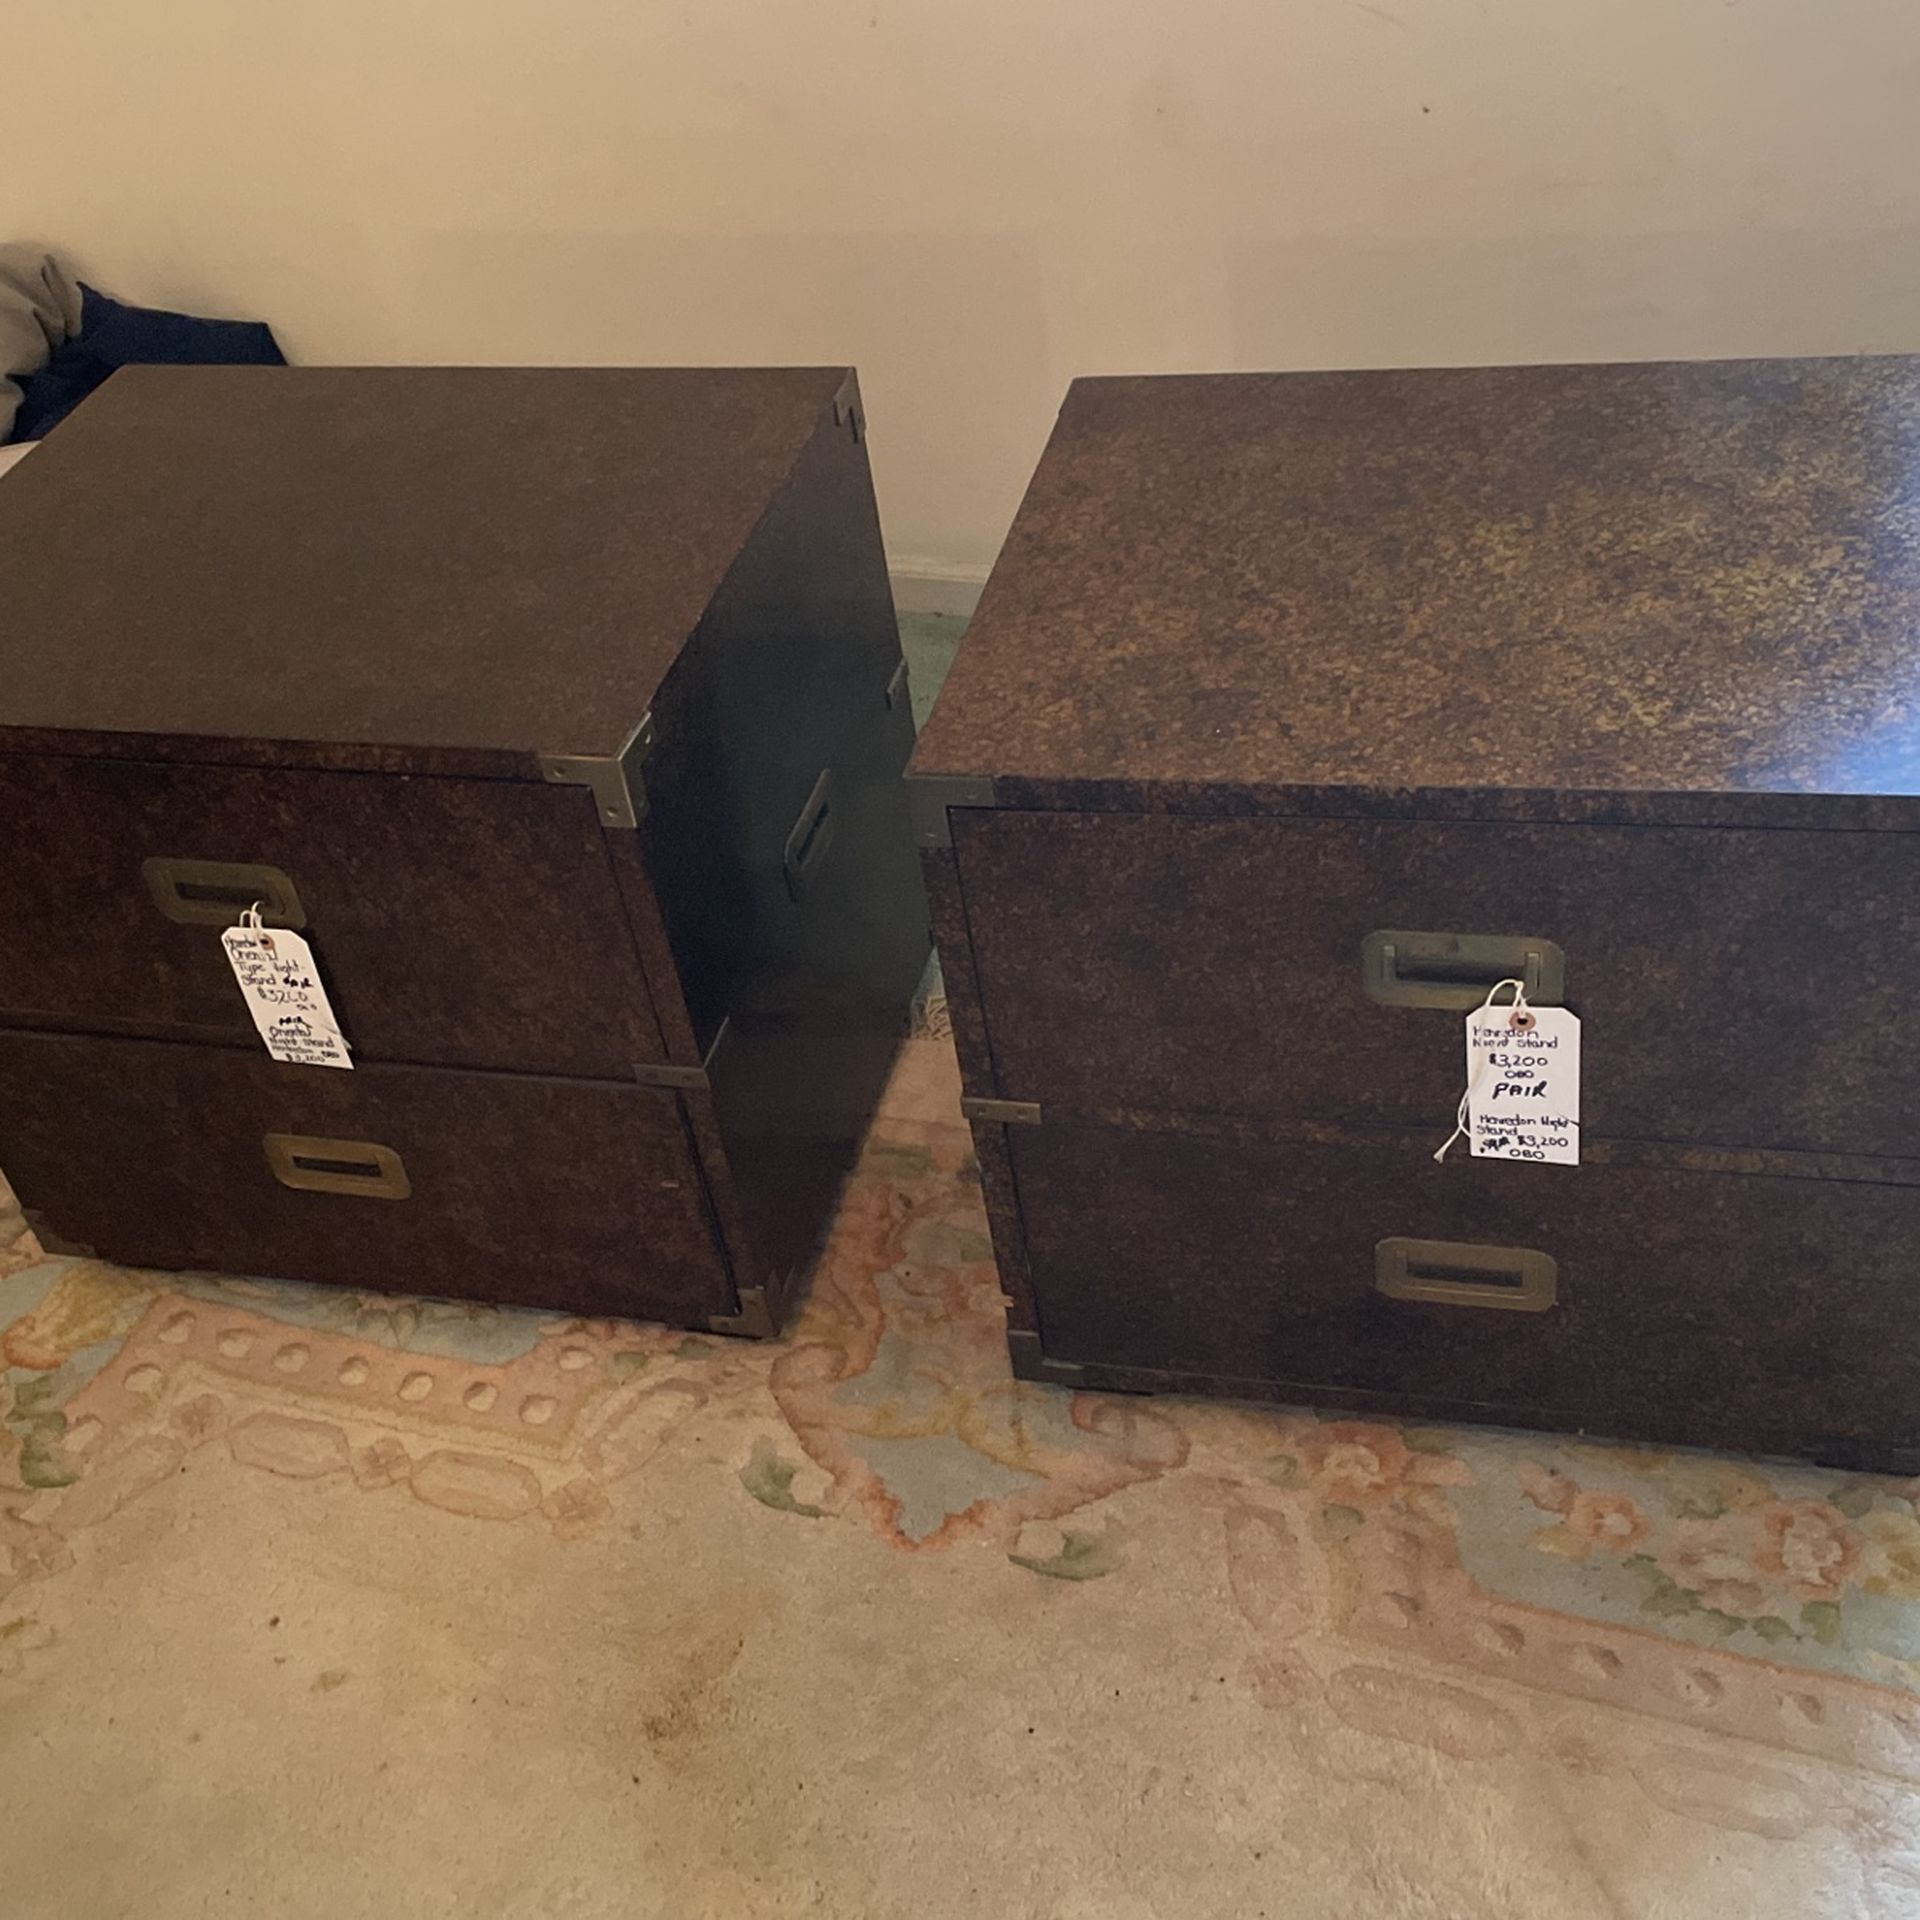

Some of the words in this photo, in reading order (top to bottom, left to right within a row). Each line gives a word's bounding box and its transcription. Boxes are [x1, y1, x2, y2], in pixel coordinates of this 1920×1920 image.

[1489, 1053, 1548, 1068] $3,200
[1492, 1081, 1547, 1100] PAIR
[1476, 1124, 1518, 1136] Stand
[1517, 1134, 1569, 1149] $3,200
[1509, 1148, 1545, 1160] OBO
